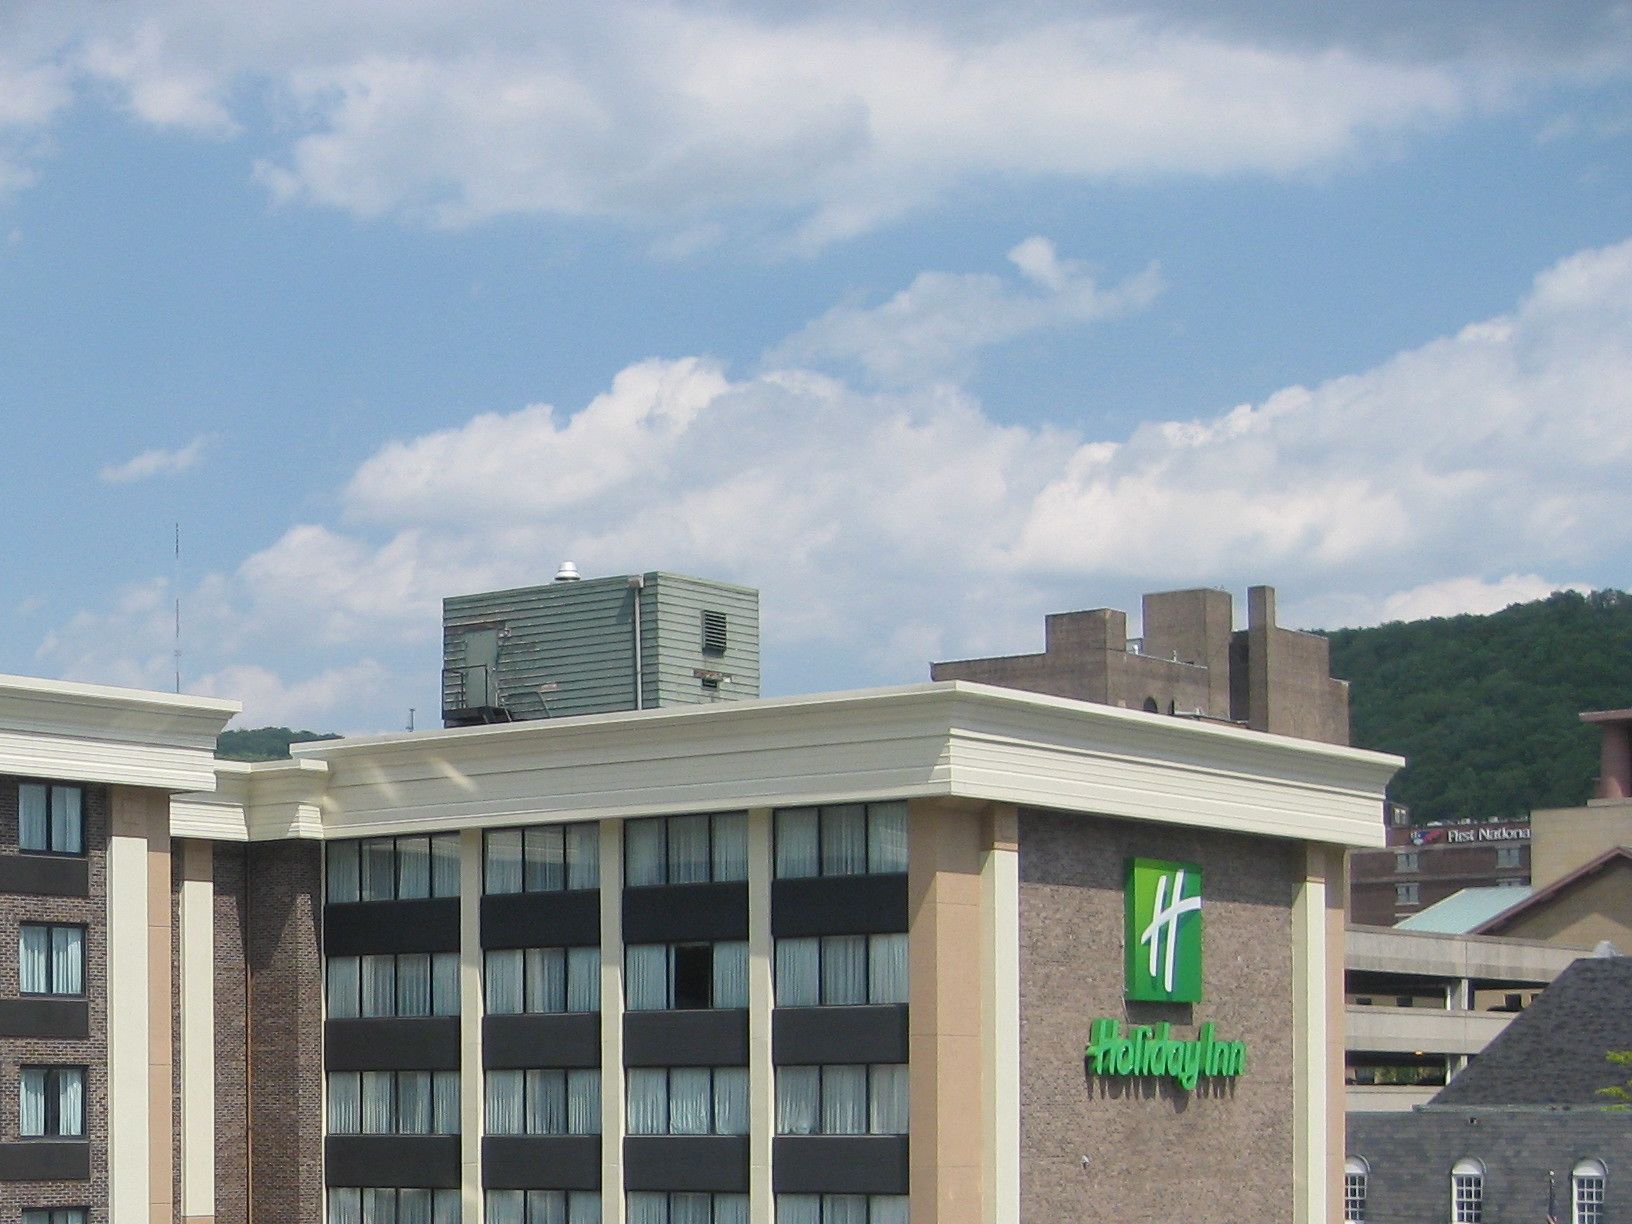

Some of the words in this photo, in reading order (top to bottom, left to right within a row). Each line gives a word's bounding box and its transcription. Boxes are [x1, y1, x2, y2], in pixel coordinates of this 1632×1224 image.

[1448, 829, 1475, 842] First
[1479, 827, 1530, 840] Nationa
[1086, 1018, 1201, 1090] Holiday
[1199, 1021, 1245, 1077] Inn
